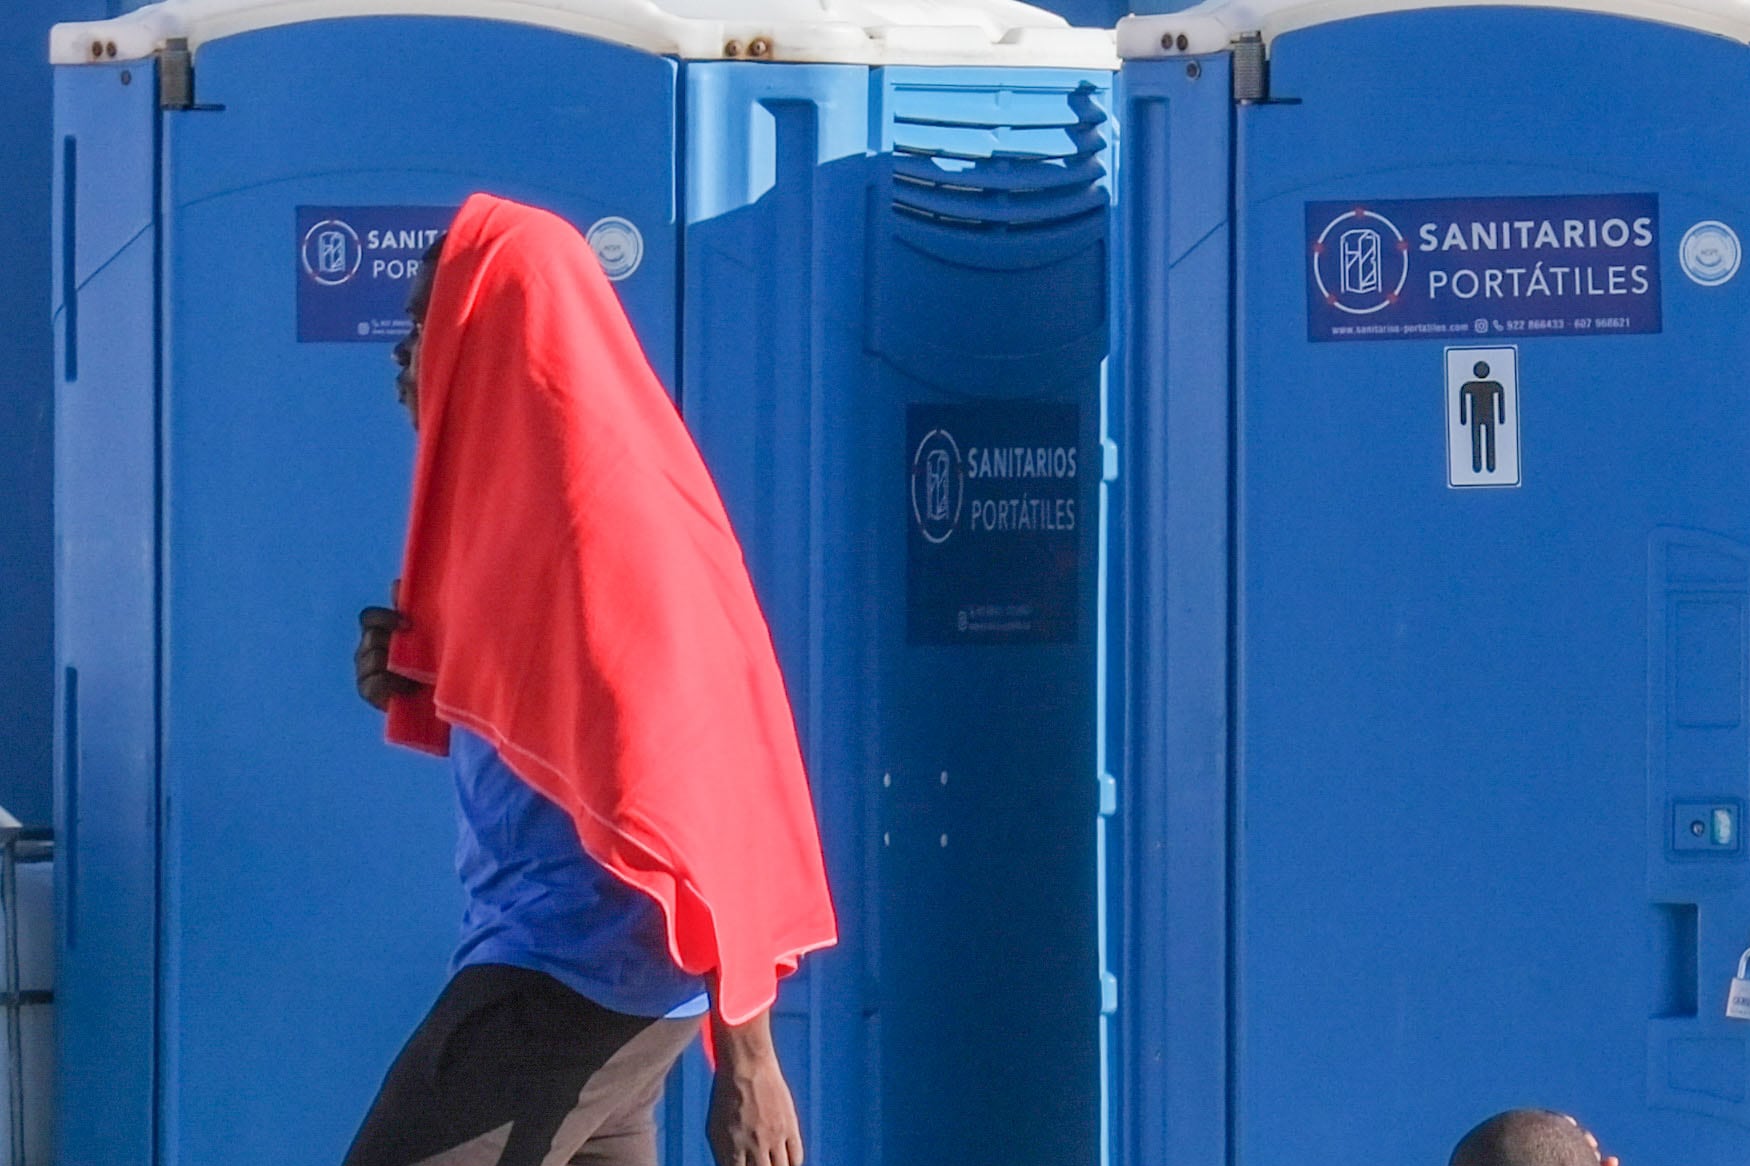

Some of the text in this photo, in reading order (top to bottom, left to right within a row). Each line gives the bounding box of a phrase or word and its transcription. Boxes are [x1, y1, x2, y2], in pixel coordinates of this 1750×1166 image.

[1419, 217, 1653, 251] SANITARIOS
[1429, 261, 1649, 299] PORTÁTILES
[968, 447, 1077, 479] SANITARIOS
[971, 493, 1075, 532] PORTÁTILES
